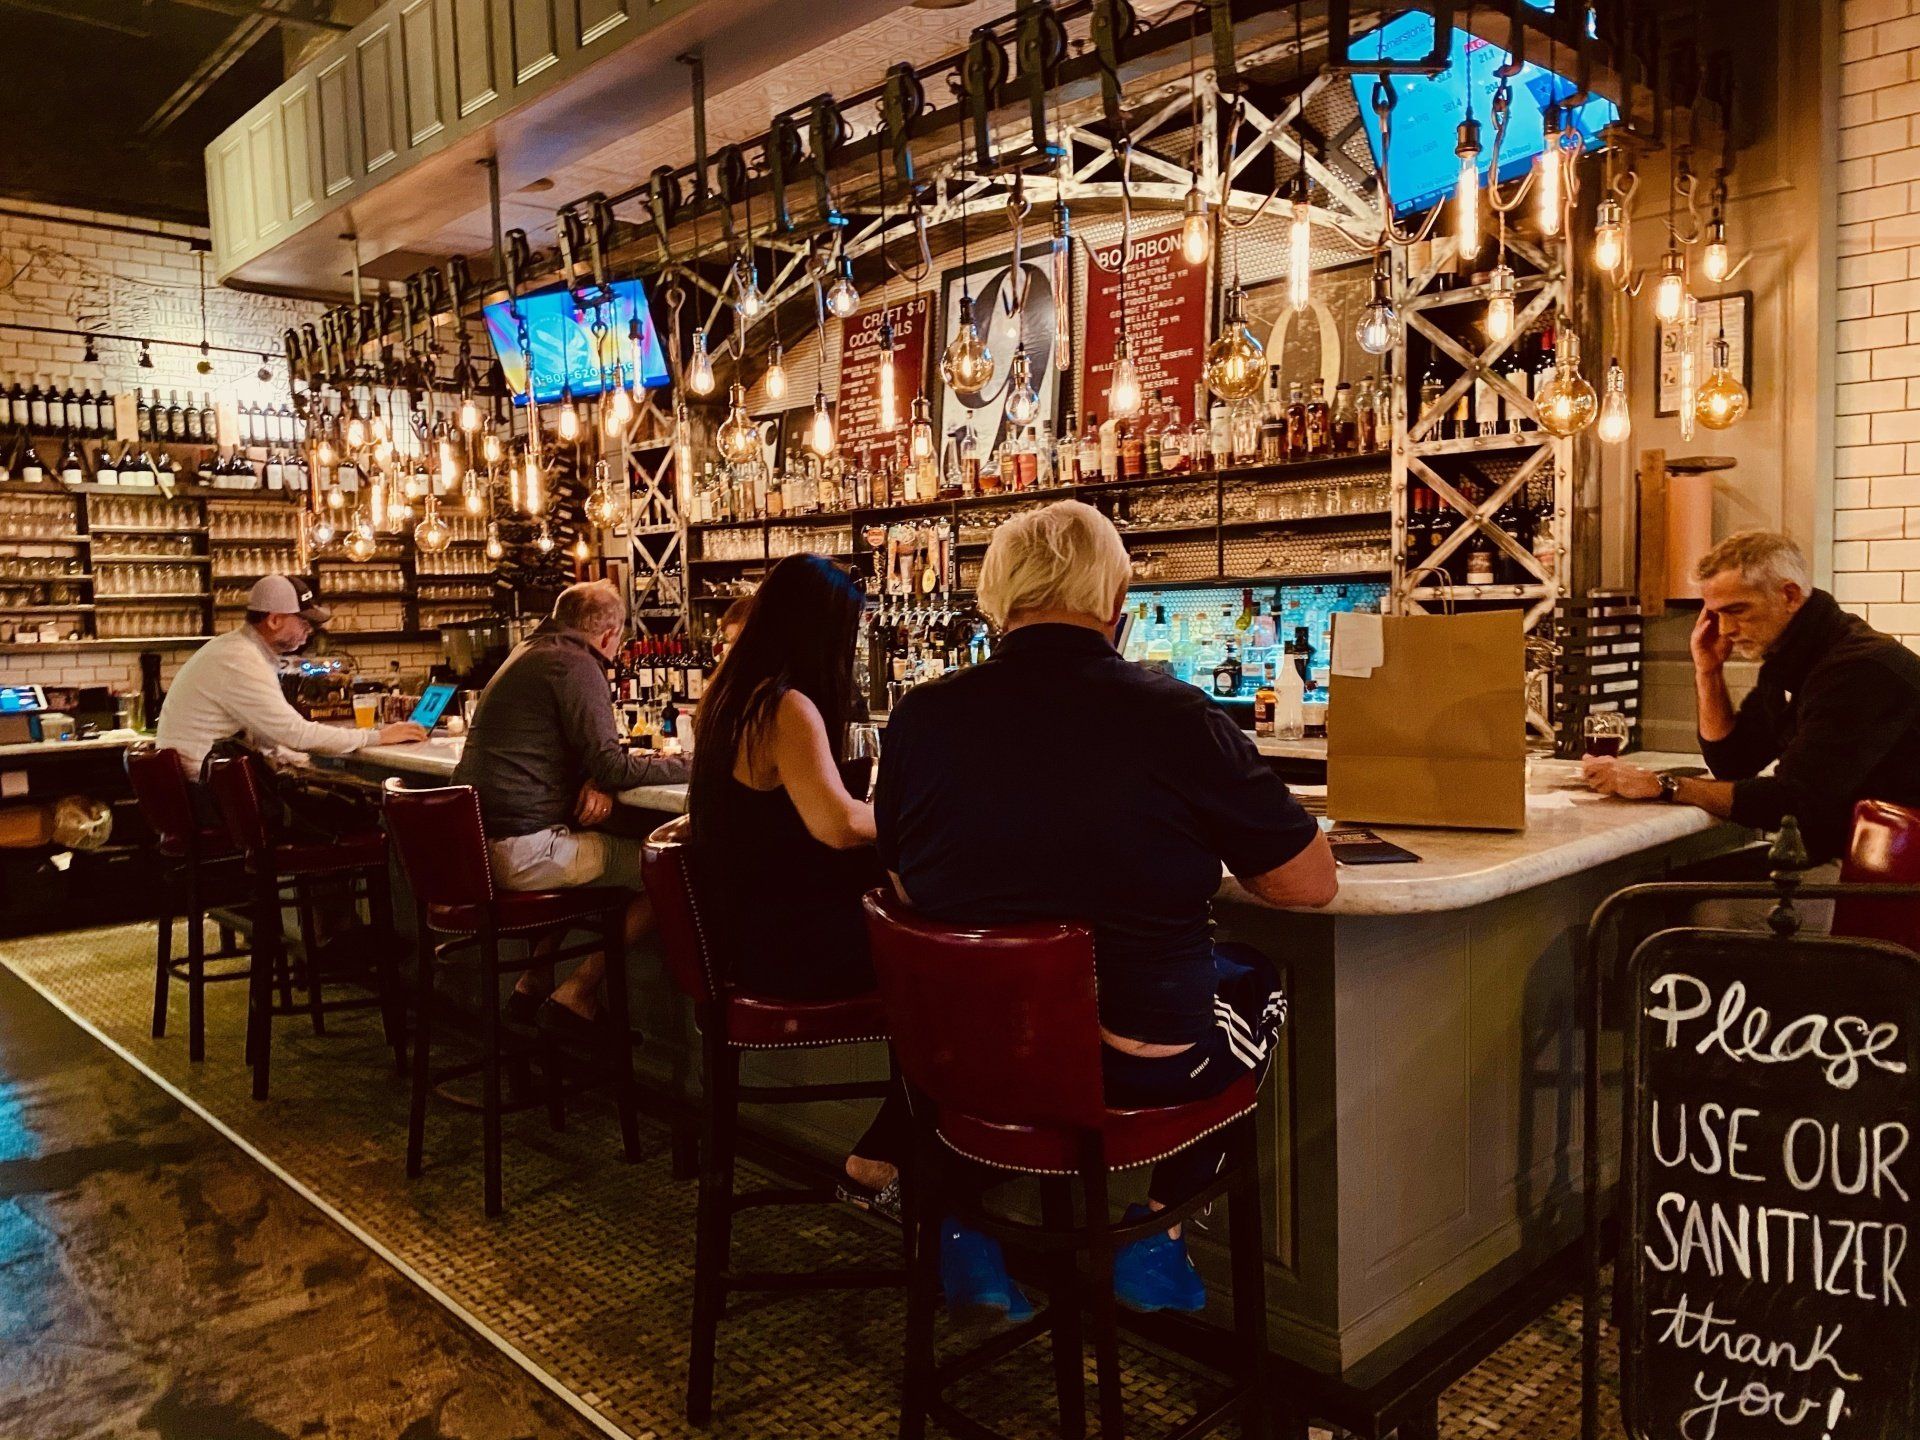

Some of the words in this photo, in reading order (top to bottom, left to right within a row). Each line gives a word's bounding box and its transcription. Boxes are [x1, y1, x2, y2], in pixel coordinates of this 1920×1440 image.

[1098, 234, 1181, 268] BOURBON
[849, 320, 913, 348] COCKILS
[1648, 973, 1908, 1090] Please
[1652, 1099, 1767, 1182] USE
[1783, 1117, 1910, 1202] OUR
[1644, 1191, 1908, 1307] SANITIZER
[1650, 1293, 1862, 1382] thank
[1680, 1370, 1847, 1440] you!
